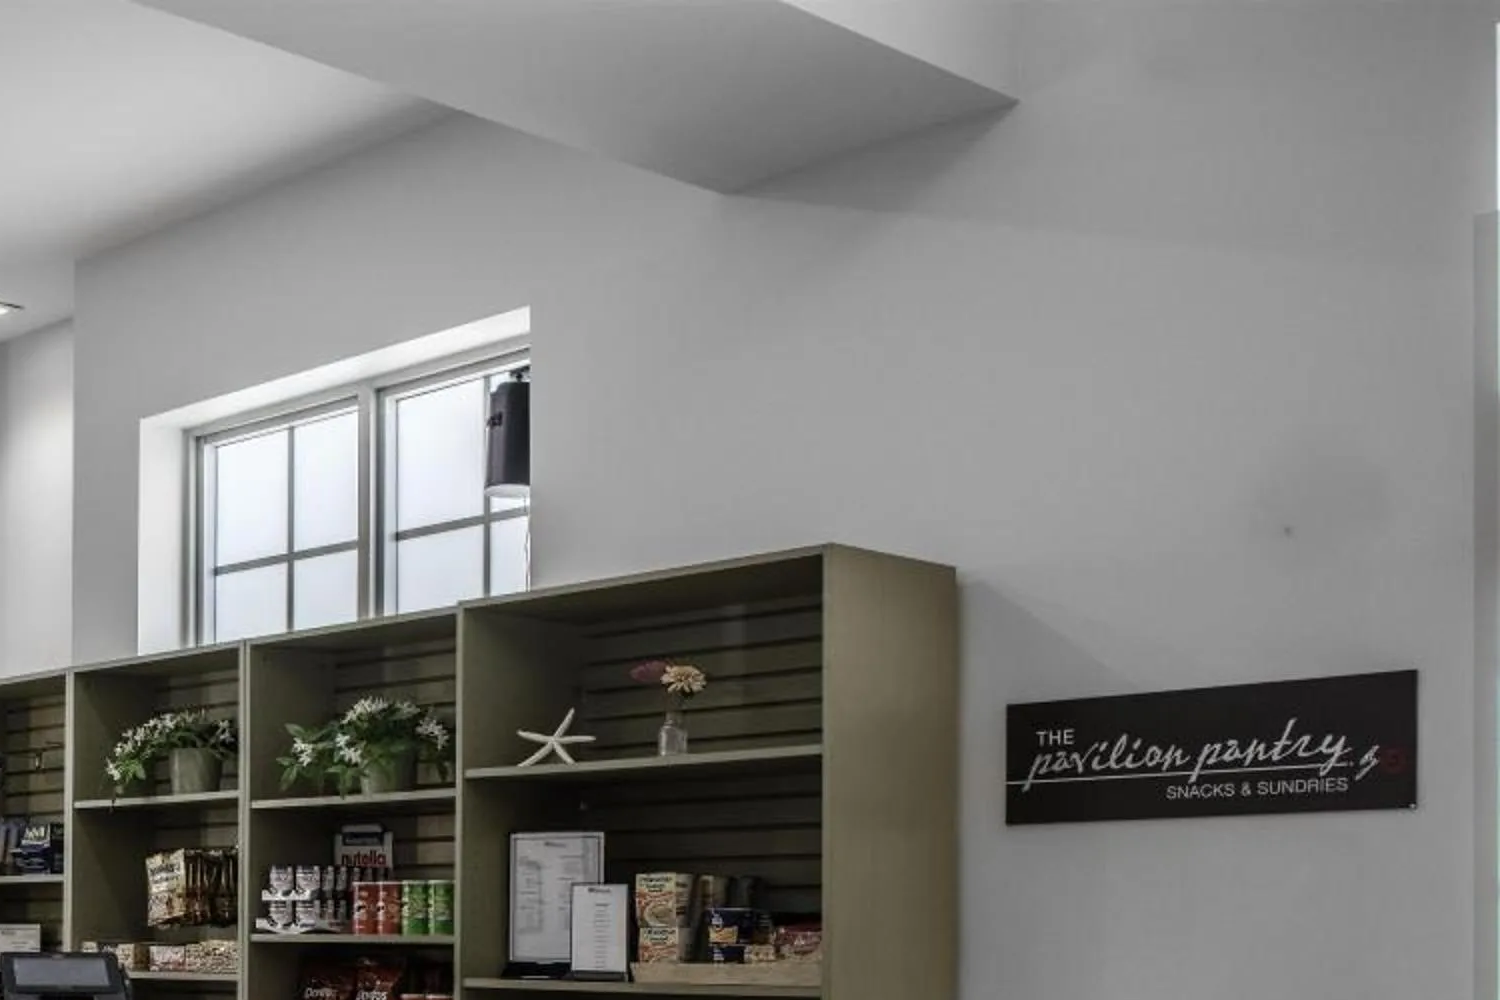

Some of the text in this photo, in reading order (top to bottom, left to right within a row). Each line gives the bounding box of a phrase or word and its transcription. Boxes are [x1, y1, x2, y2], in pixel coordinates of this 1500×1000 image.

[1036, 729, 1075, 746] THE
[1022, 733, 1191, 792] pavilion
[1166, 777, 1348, 800] SNACKS & SUNDRIES
